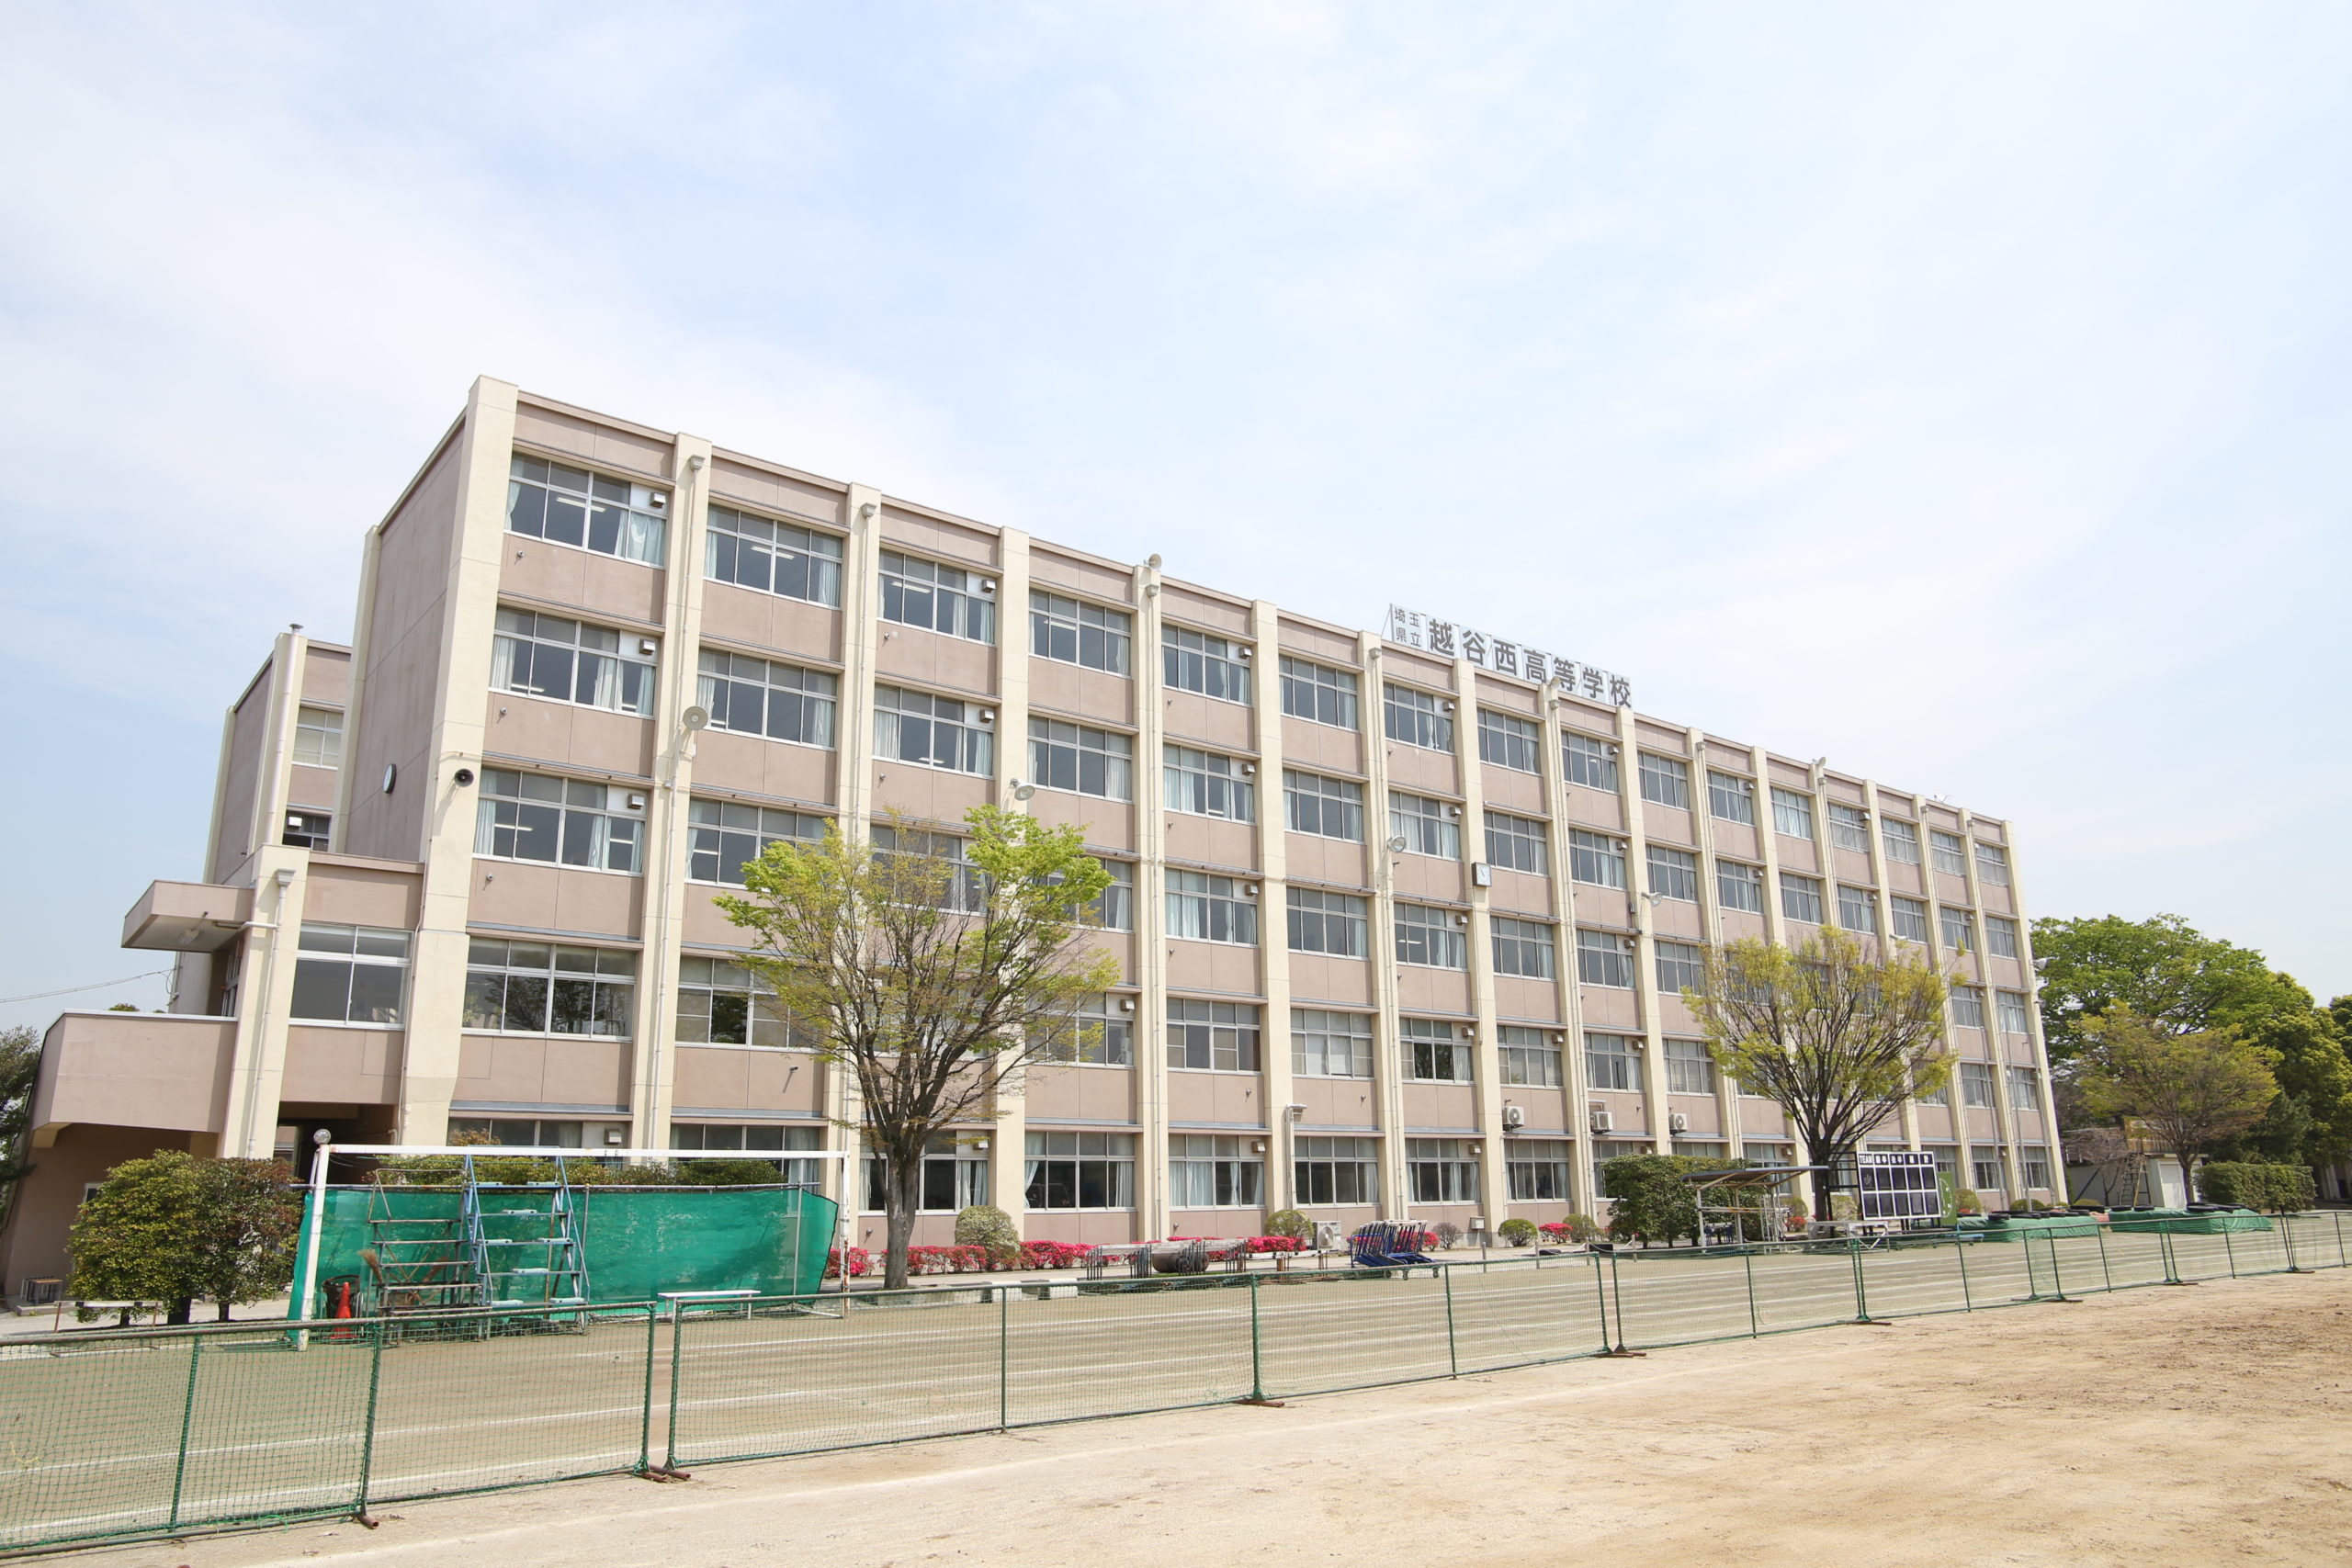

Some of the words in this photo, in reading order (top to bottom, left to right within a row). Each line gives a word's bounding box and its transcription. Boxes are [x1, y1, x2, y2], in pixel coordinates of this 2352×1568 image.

[1395, 606, 1419, 627] 埼玉
[1396, 626, 1421, 647] 県立
[1429, 618, 1632, 708] 越谷西高等学校
[1859, 1155, 1873, 1164] TEAM
